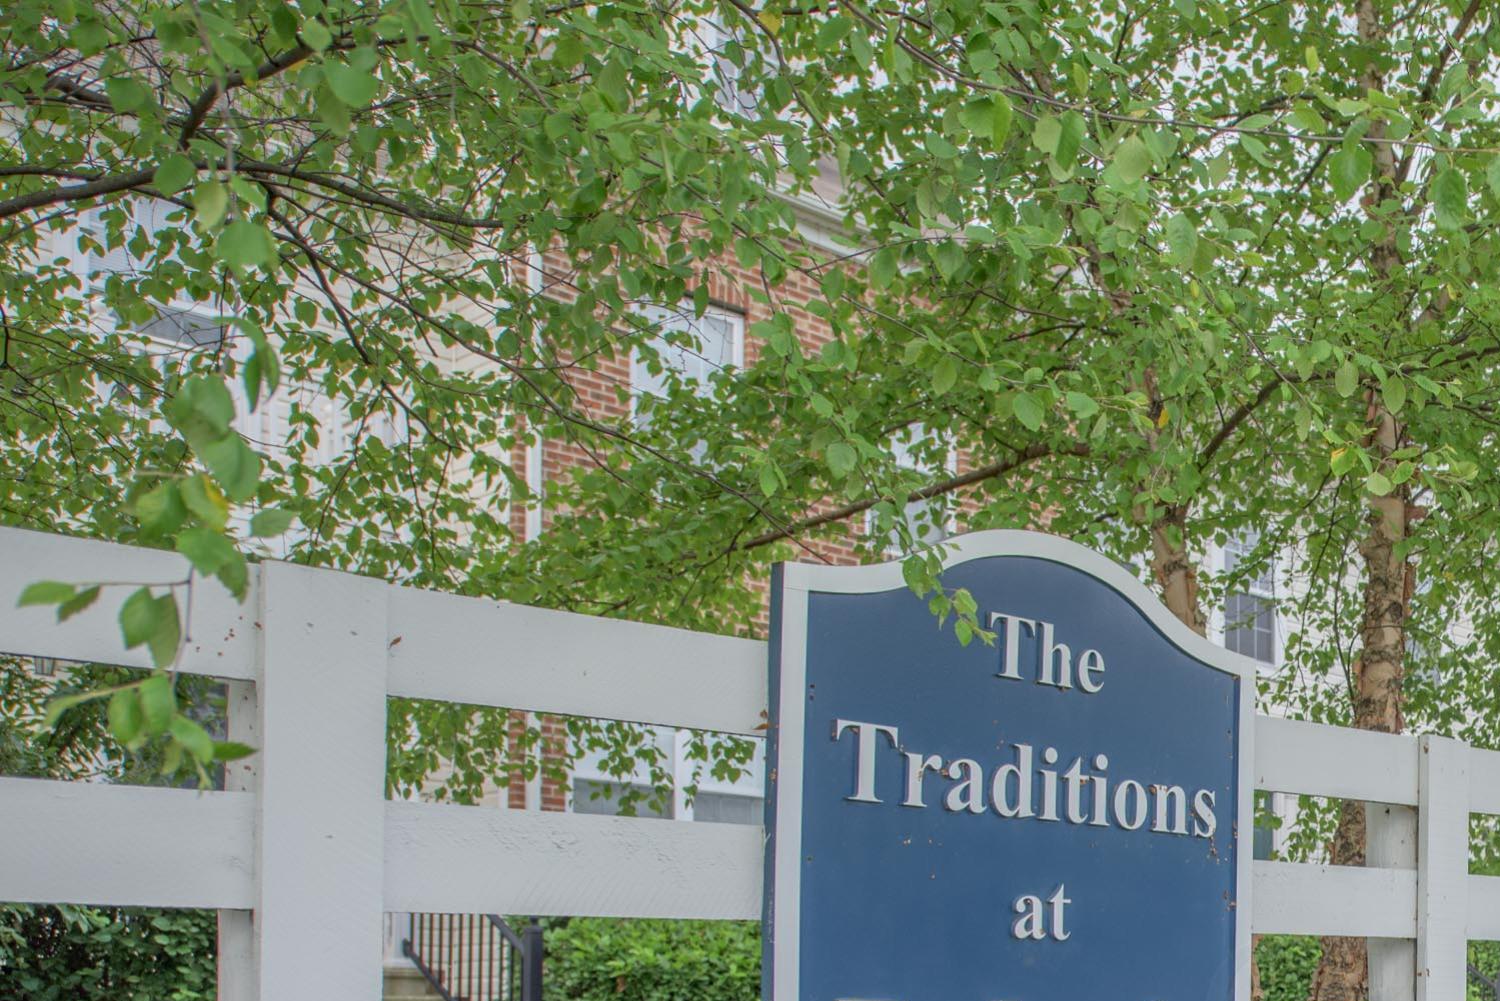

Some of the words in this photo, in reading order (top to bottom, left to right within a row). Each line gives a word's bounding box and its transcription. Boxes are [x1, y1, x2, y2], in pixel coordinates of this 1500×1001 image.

[990, 611, 1106, 693] The
[836, 718, 1217, 838] Traditions
[1014, 884, 1072, 941] at
